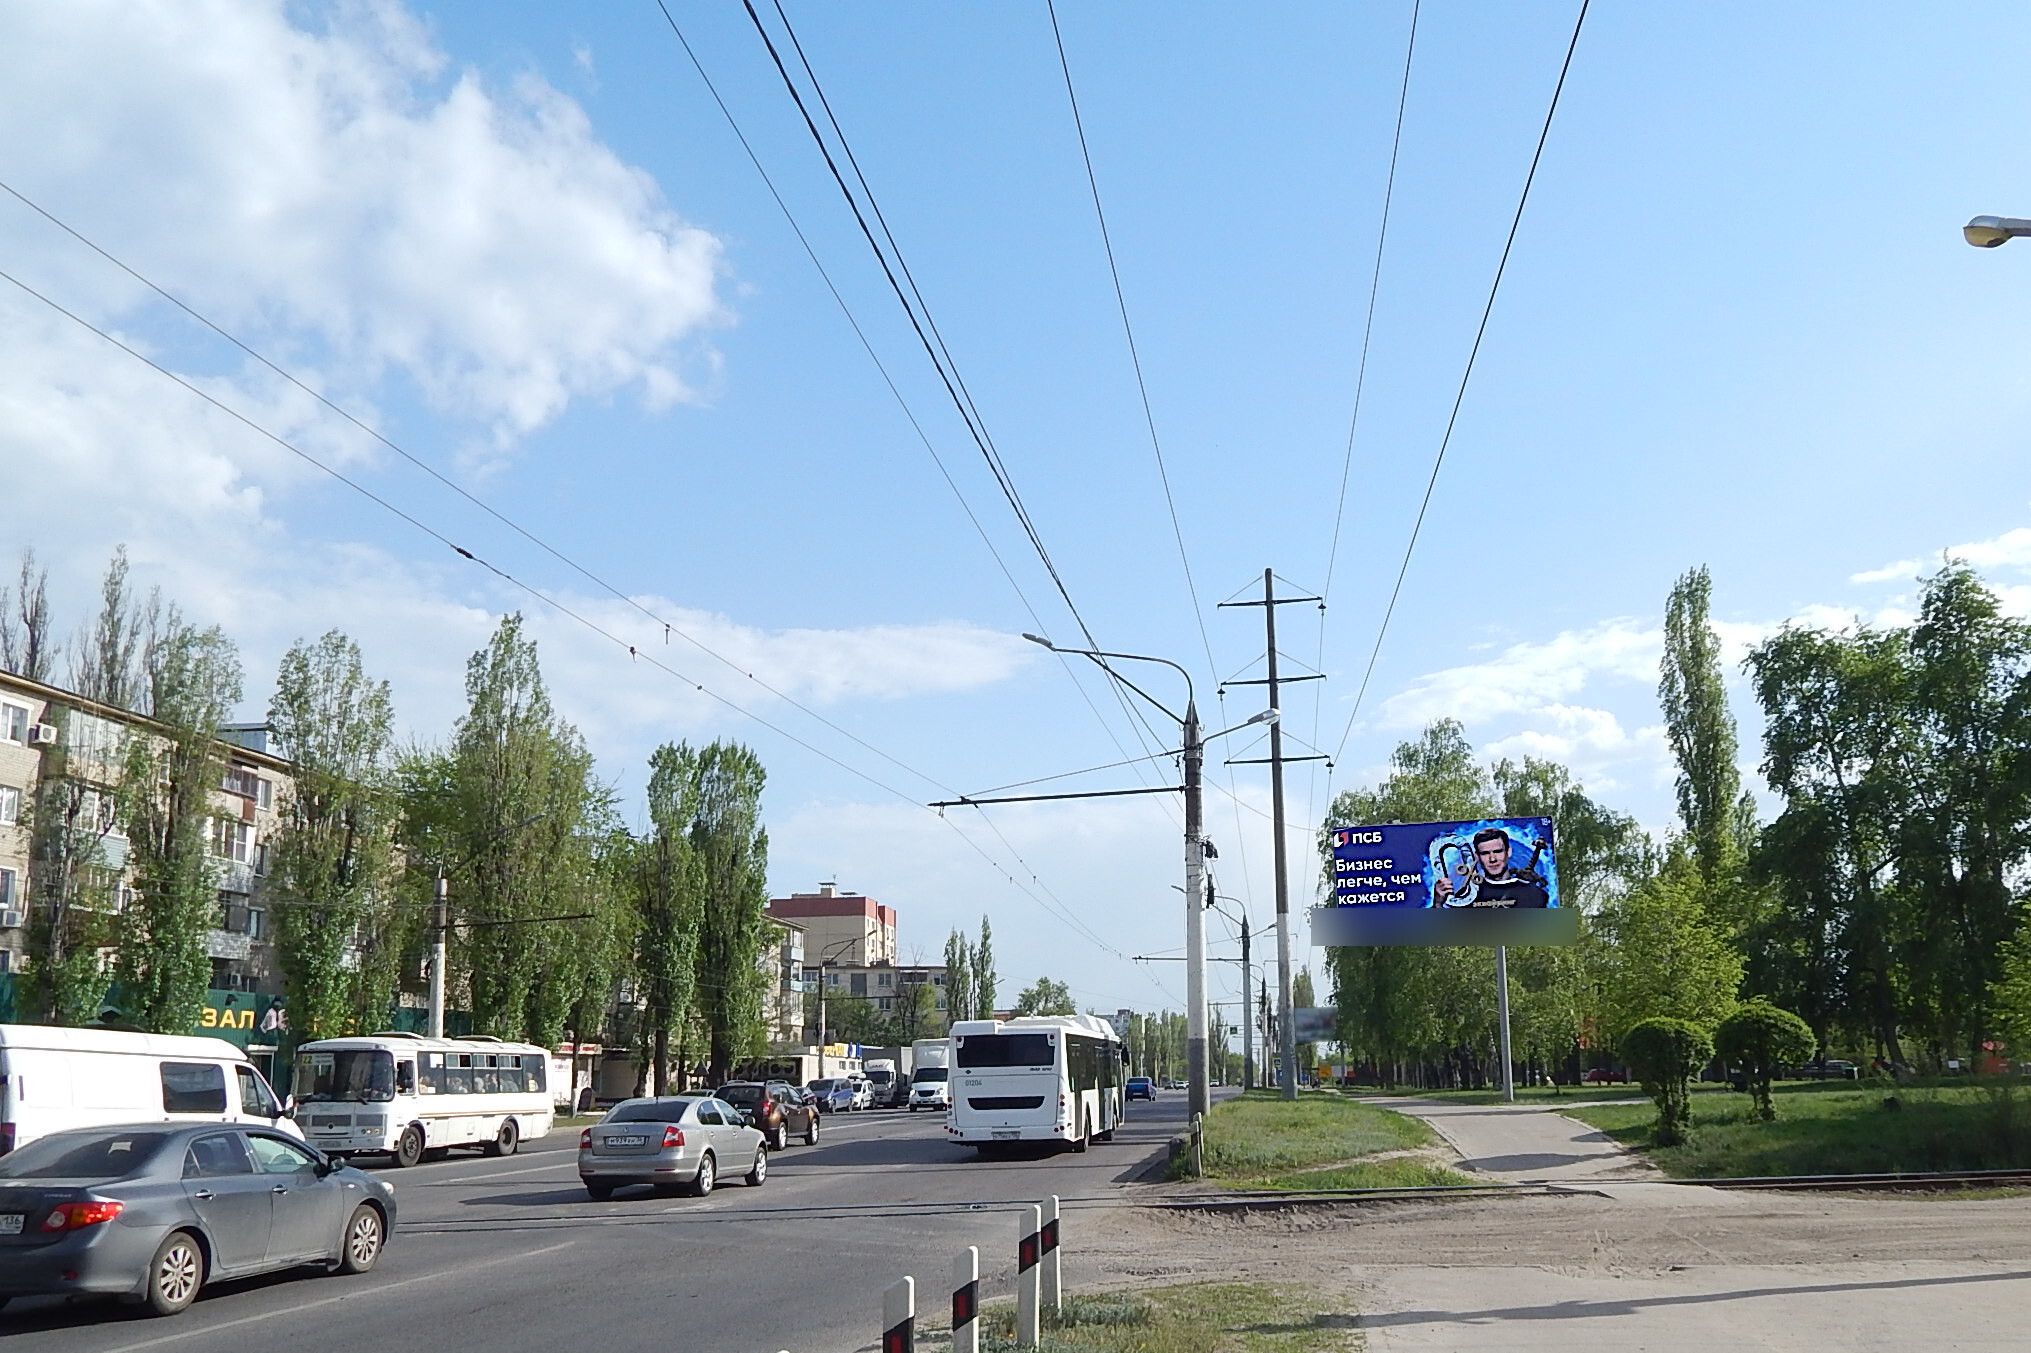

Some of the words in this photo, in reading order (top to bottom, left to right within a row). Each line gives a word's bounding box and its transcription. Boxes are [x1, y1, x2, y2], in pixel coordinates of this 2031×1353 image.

[1352, 832, 1383, 844] ПСБ
[1335, 859, 1393, 872] Бизнес
[1336, 876, 1387, 888] легче,
[1390, 873, 1422, 884] чем
[1338, 891, 1405, 905] кажется
[201, 1007, 256, 1029] ЗАЛ
